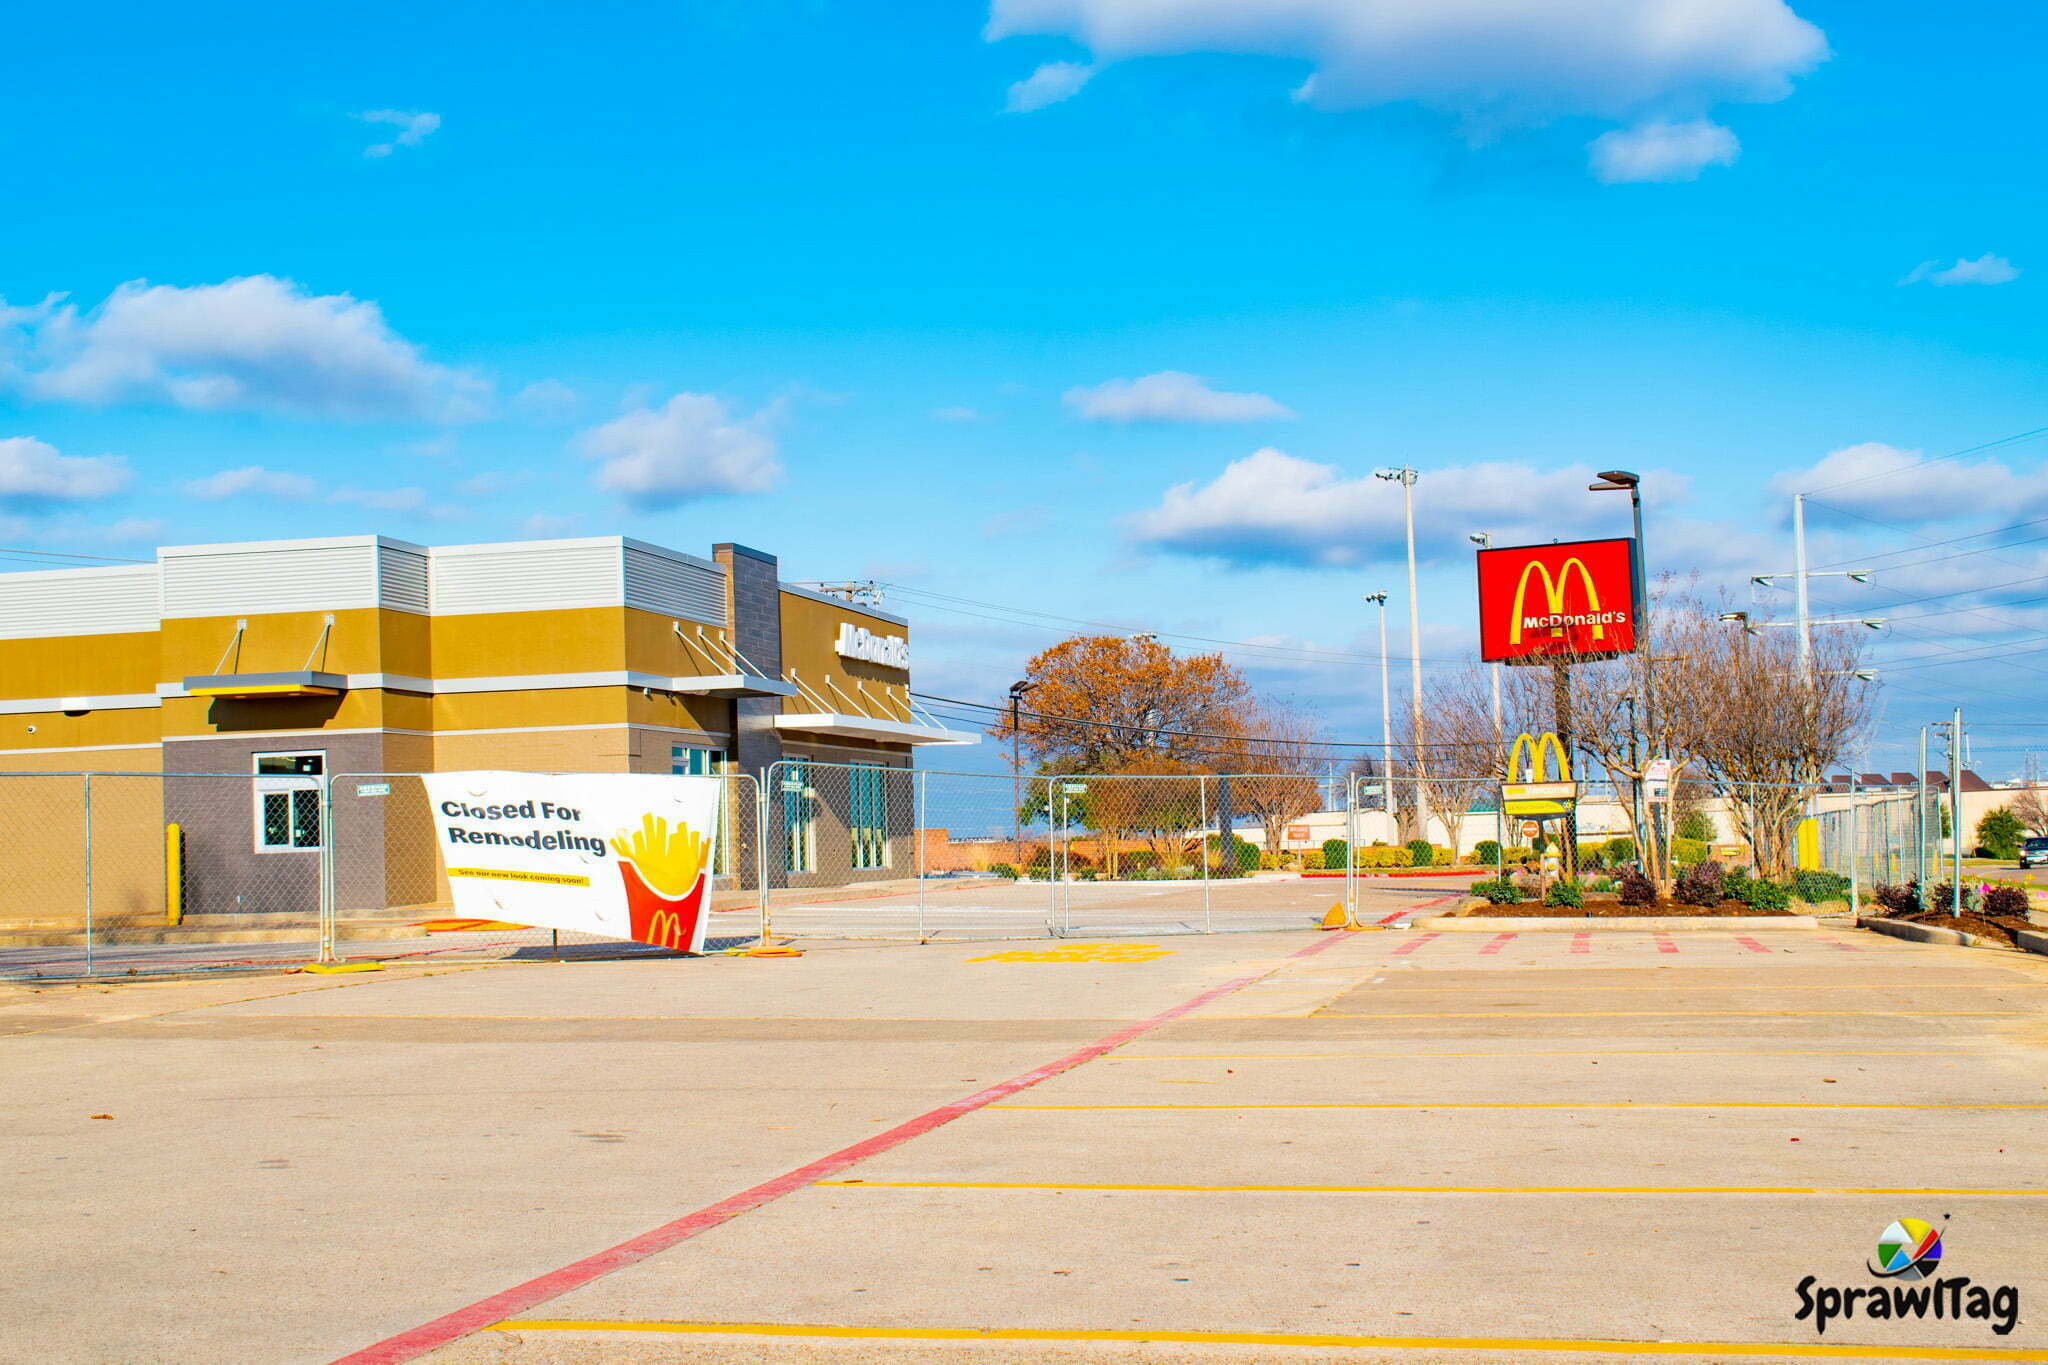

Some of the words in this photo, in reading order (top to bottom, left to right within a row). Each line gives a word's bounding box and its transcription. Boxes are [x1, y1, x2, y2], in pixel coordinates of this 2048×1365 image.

[1523, 611, 1626, 629] McDonald's
[441, 800, 536, 820] Closed
[541, 801, 582, 821] For
[448, 827, 606, 857] Remodeling
[530, 874, 560, 883] coming
[562, 877, 584, 885] soon!
